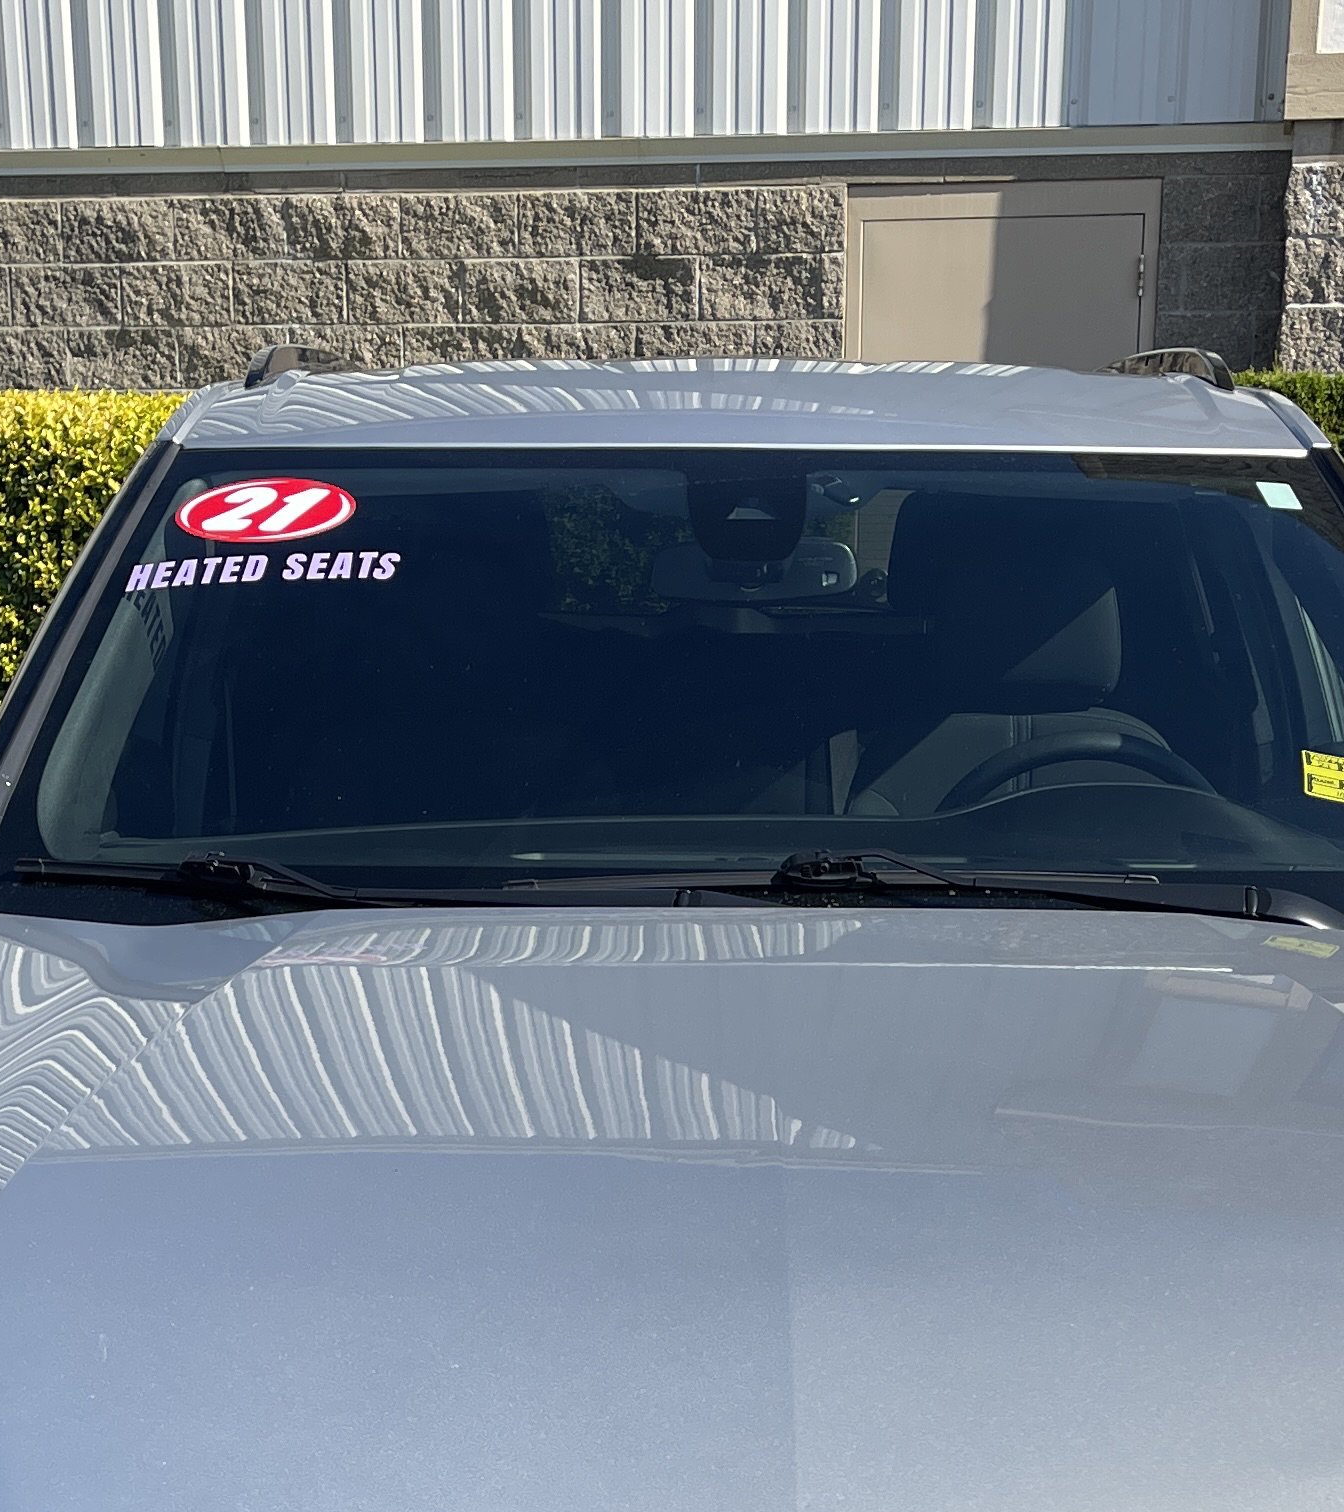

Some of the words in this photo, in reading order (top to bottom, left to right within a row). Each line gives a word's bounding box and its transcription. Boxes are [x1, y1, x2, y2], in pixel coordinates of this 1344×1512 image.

[201, 486, 331, 532] 21
[125, 554, 269, 592] HEATED
[282, 551, 401, 581] SEATS
